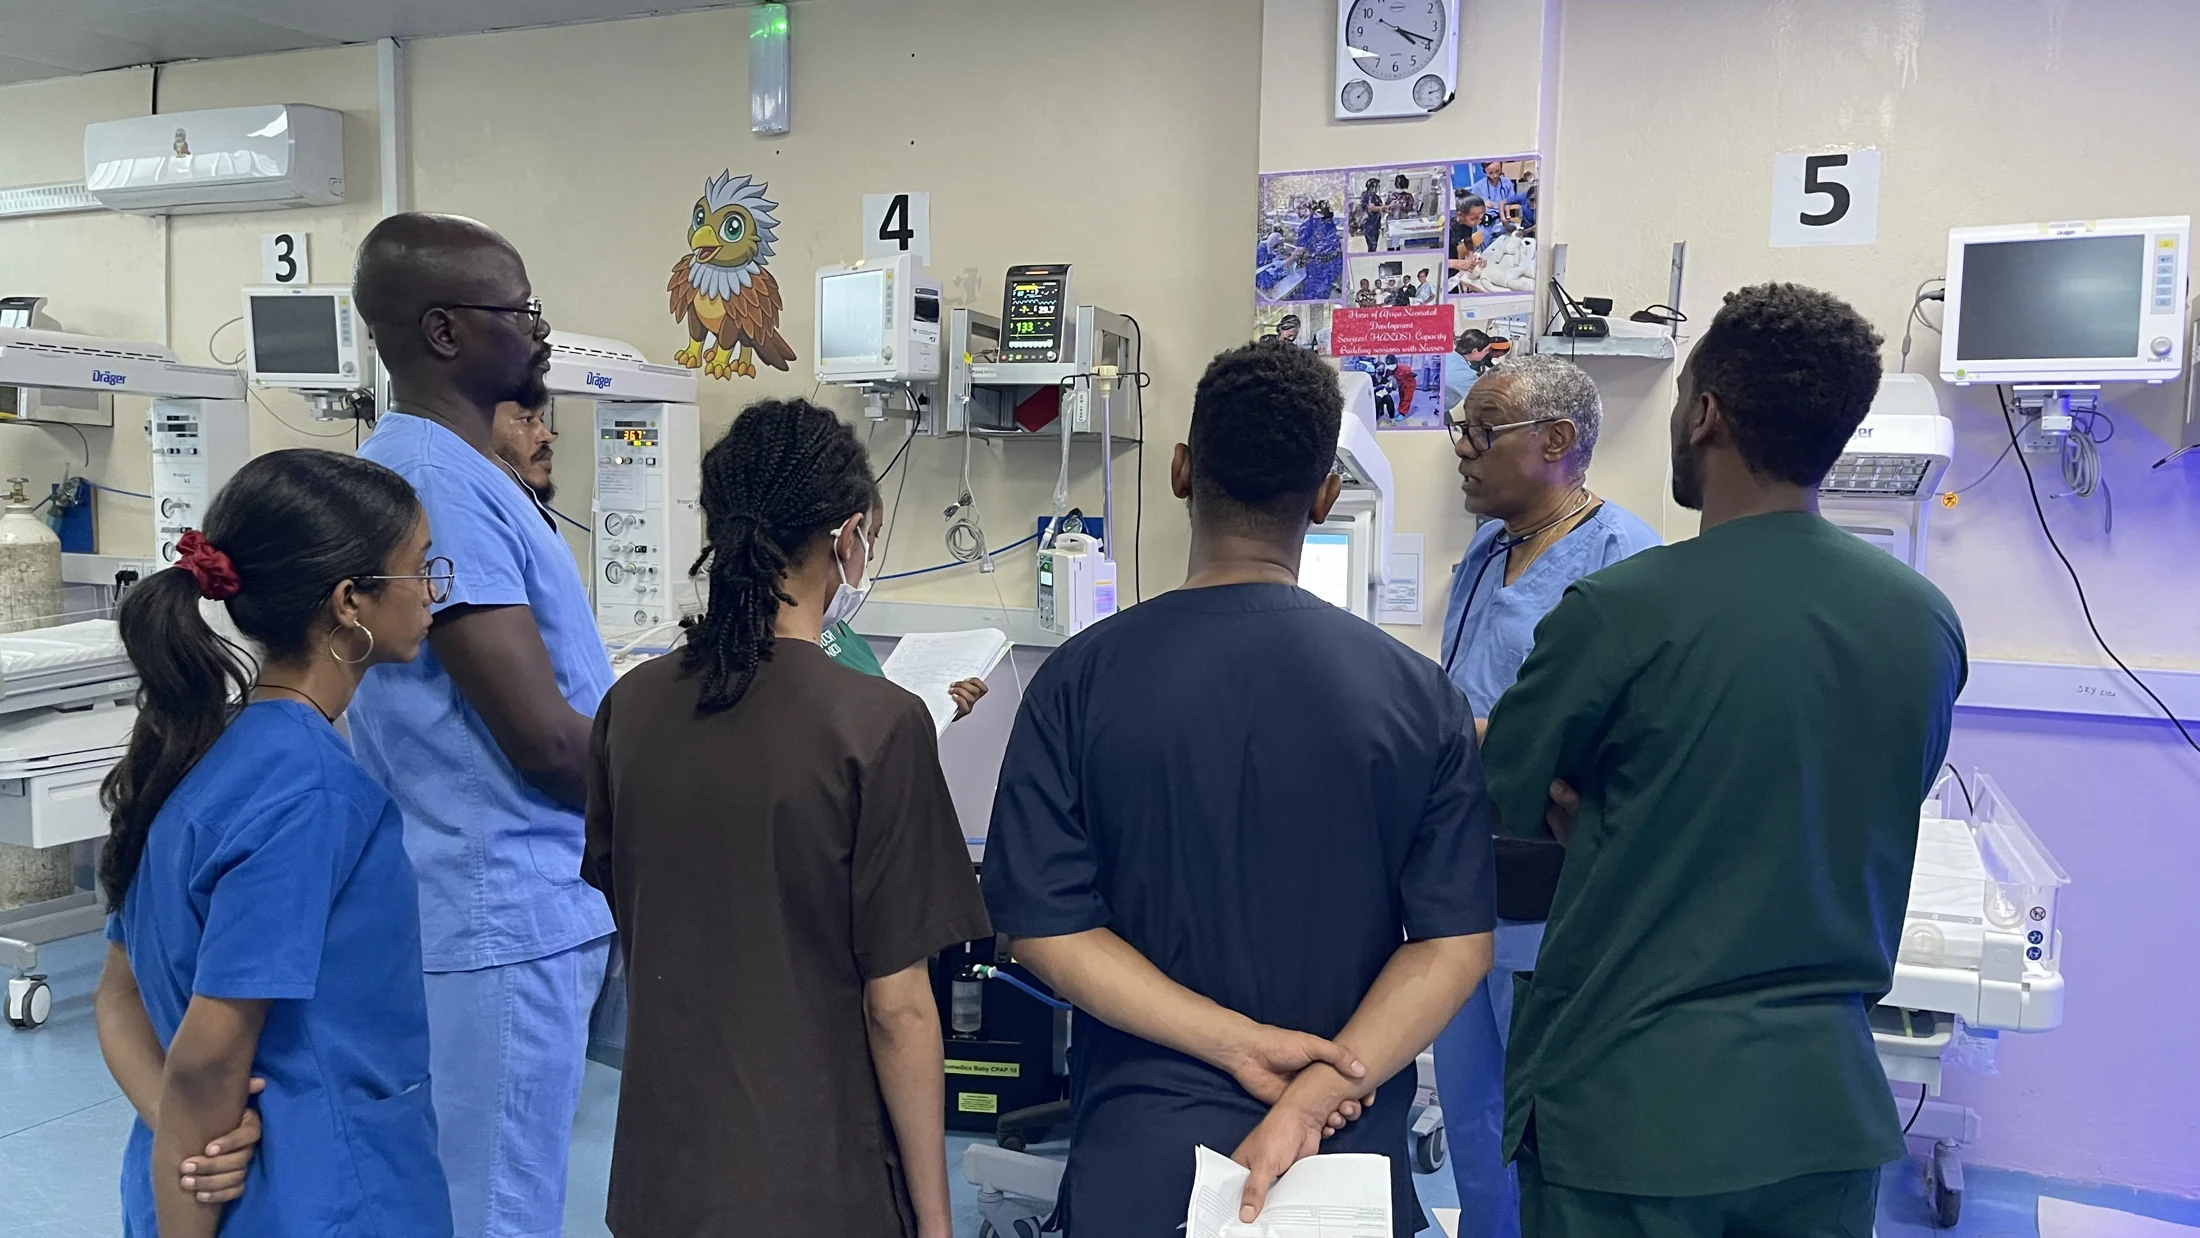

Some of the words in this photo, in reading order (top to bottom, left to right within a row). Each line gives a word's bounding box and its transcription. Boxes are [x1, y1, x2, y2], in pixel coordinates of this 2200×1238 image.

[1363, 8, 1373, 19] 10
[1427, 3, 1434, 14] 2
[1356, 26, 1364, 37] 9
[1431, 20, 1438, 32] 3
[1424, 41, 1431, 52] 4
[1375, 57, 1381, 68] 7
[1410, 55, 1417, 66] 5
[1392, 61, 1399, 72] 6
[1799, 153, 1851, 227] 5
[879, 194, 914, 251] 4
[274, 233, 297, 283] 3
[1348, 310, 1369, 319] Horn
[1371, 310, 1378, 320] of
[1380, 309, 1402, 319] Africa
[1403, 308, 1438, 317] Neonatal
[1016, 321, 1034, 332] 133
[1369, 322, 1414, 330] Development
[1415, 331, 1447, 341] Capacity
[1339, 346, 1371, 355] Building
[1401, 345, 1417, 353] with
[1418, 344, 1445, 353] Nurses
[92, 369, 127, 386] Dräger
[586, 371, 612, 389] Dräger
[973, 1065, 989, 1073] Baby
